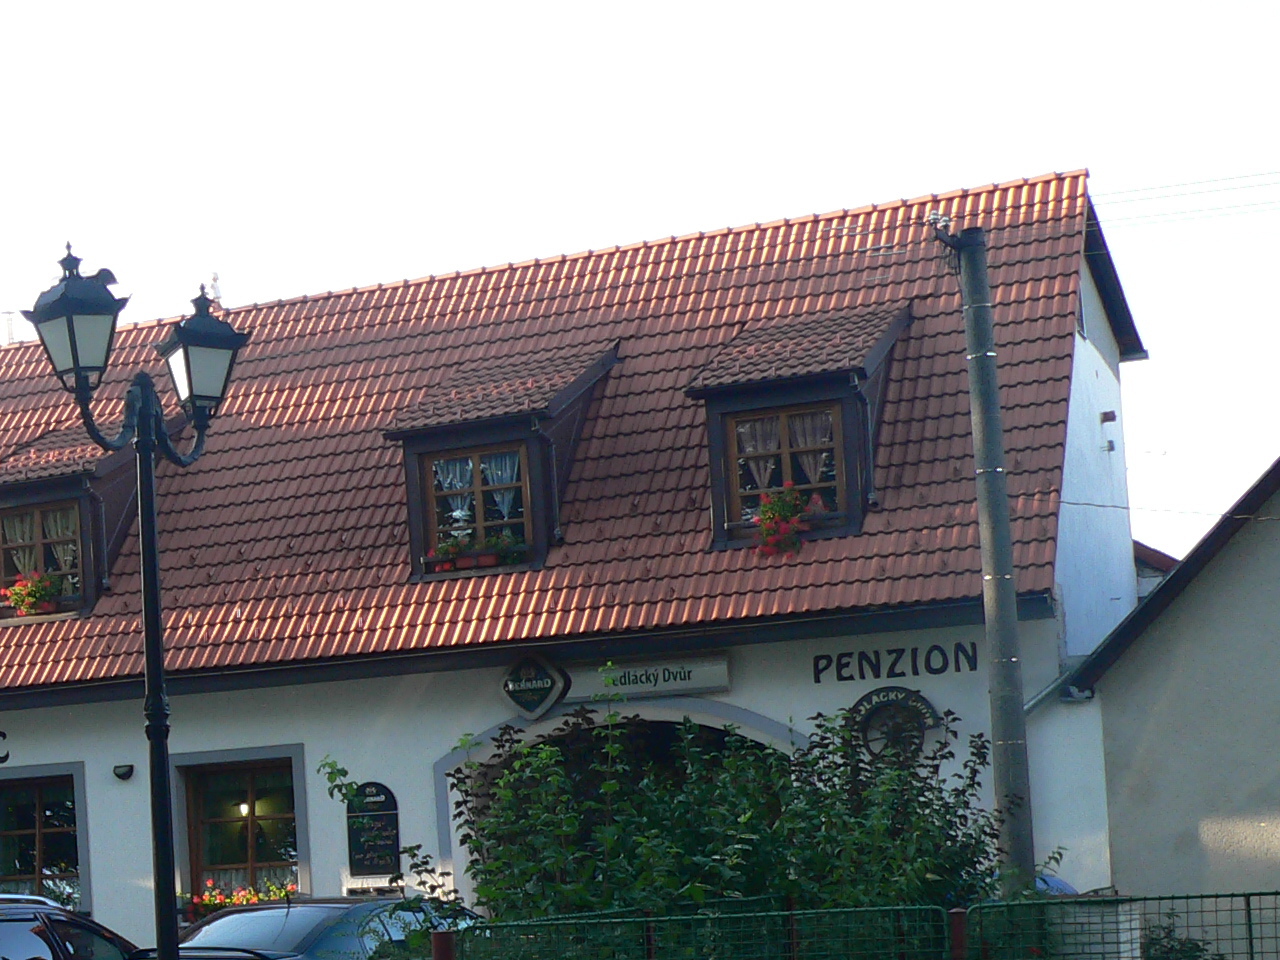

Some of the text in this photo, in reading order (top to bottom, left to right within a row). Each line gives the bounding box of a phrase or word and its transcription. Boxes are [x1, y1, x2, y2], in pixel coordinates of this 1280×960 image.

[604, 666, 693, 687] edlácký Dvůr
[813, 642, 978, 684] PENZION
